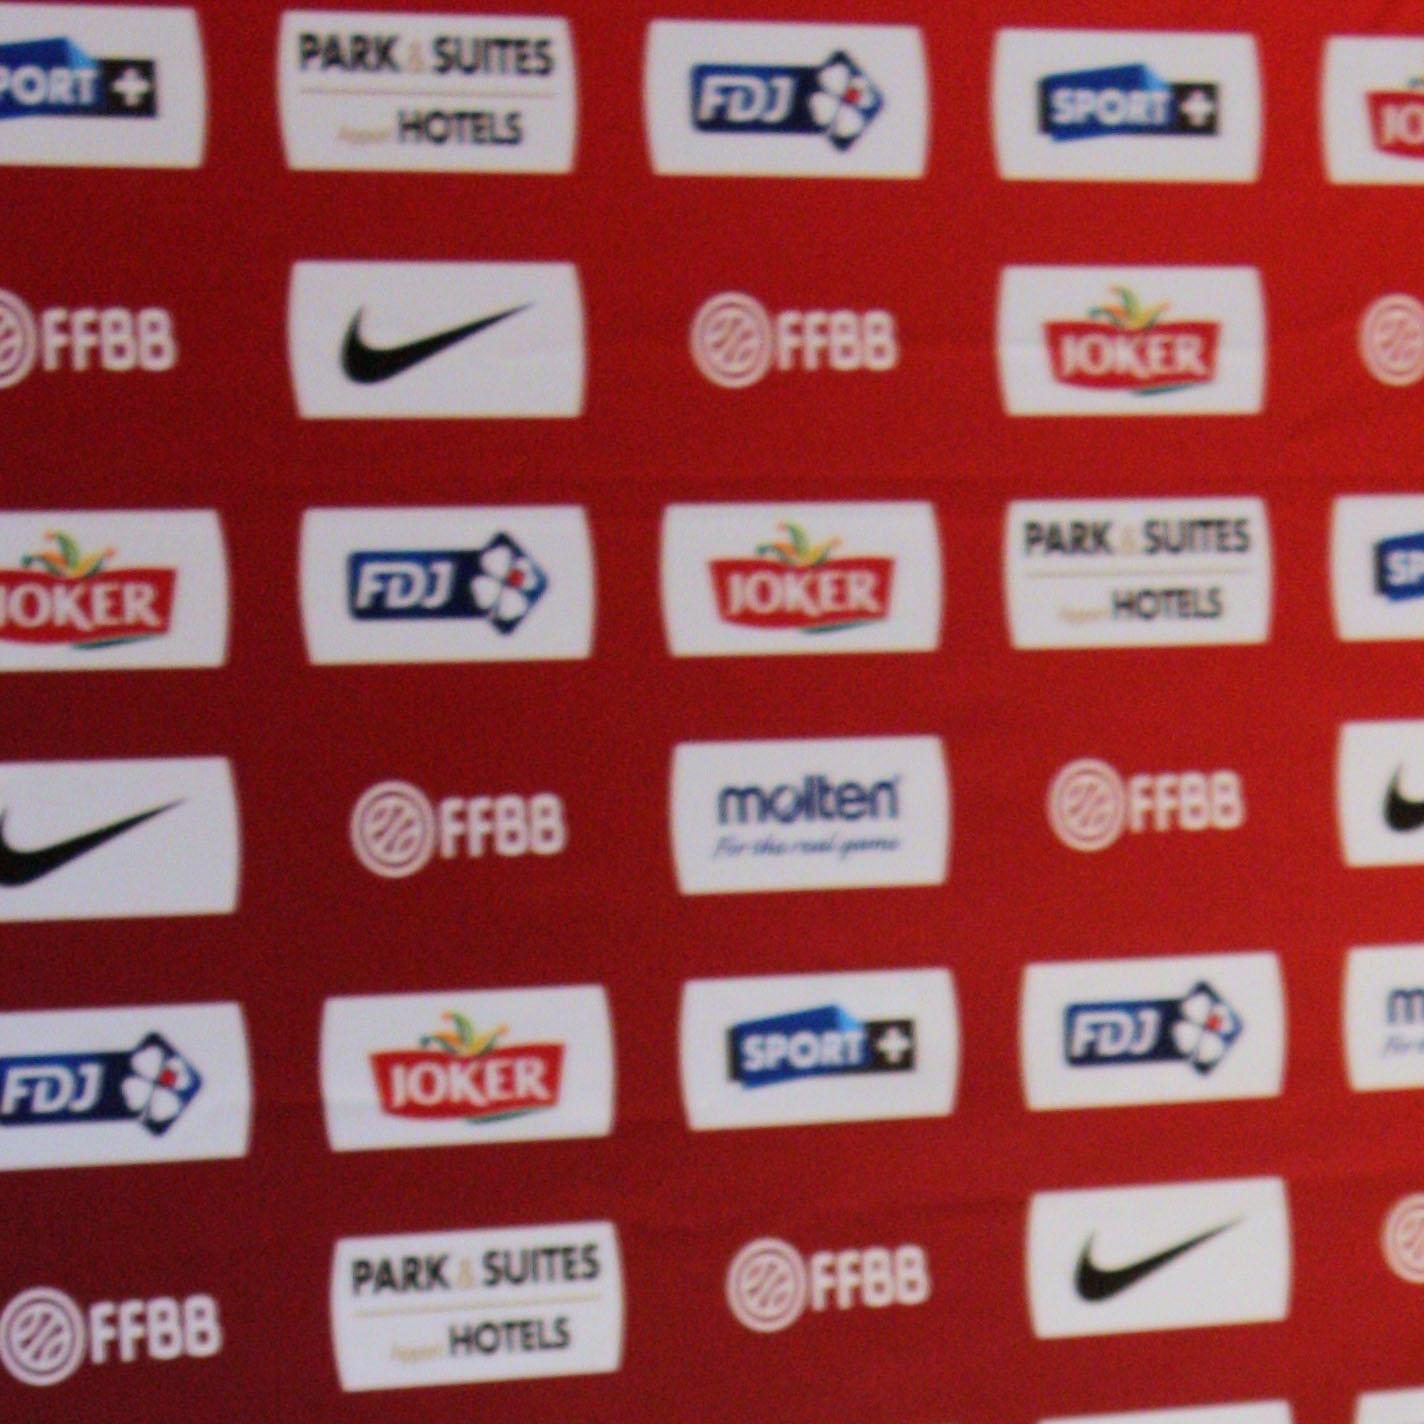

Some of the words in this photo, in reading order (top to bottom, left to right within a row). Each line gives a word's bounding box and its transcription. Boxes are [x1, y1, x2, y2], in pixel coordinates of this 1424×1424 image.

[298, 33, 399, 72] PARK
[432, 36, 554, 75] SUITES
[699, 72, 796, 127] FDJ
[396, 109, 524, 146] HOTELS
[42, 306, 176, 373] FFBB
[774, 309, 898, 372] FFBB
[1059, 330, 1210, 378] JOKER
[1024, 519, 1113, 555] PARK
[1143, 519, 1251, 555] SUITES
[0, 583, 158, 631] OKER
[357, 562, 454, 611] FDJ
[728, 567, 882, 617] JOKER
[1112, 587, 1222, 620] HOTELS
[717, 774, 900, 825] molten
[1127, 769, 1245, 832] FFBB
[437, 792, 568, 860] FFBB
[1072, 1011, 1159, 1059] FDJ
[1, 1061, 106, 1116] FDJ
[389, 1055, 553, 1109] JOKER
[351, 1254, 450, 1296] PARK
[482, 1244, 600, 1287] SUITES
[810, 1244, 931, 1311] FFBB
[89, 1294, 223, 1364] FFBB
[448, 1317, 571, 1357] HOTELS
